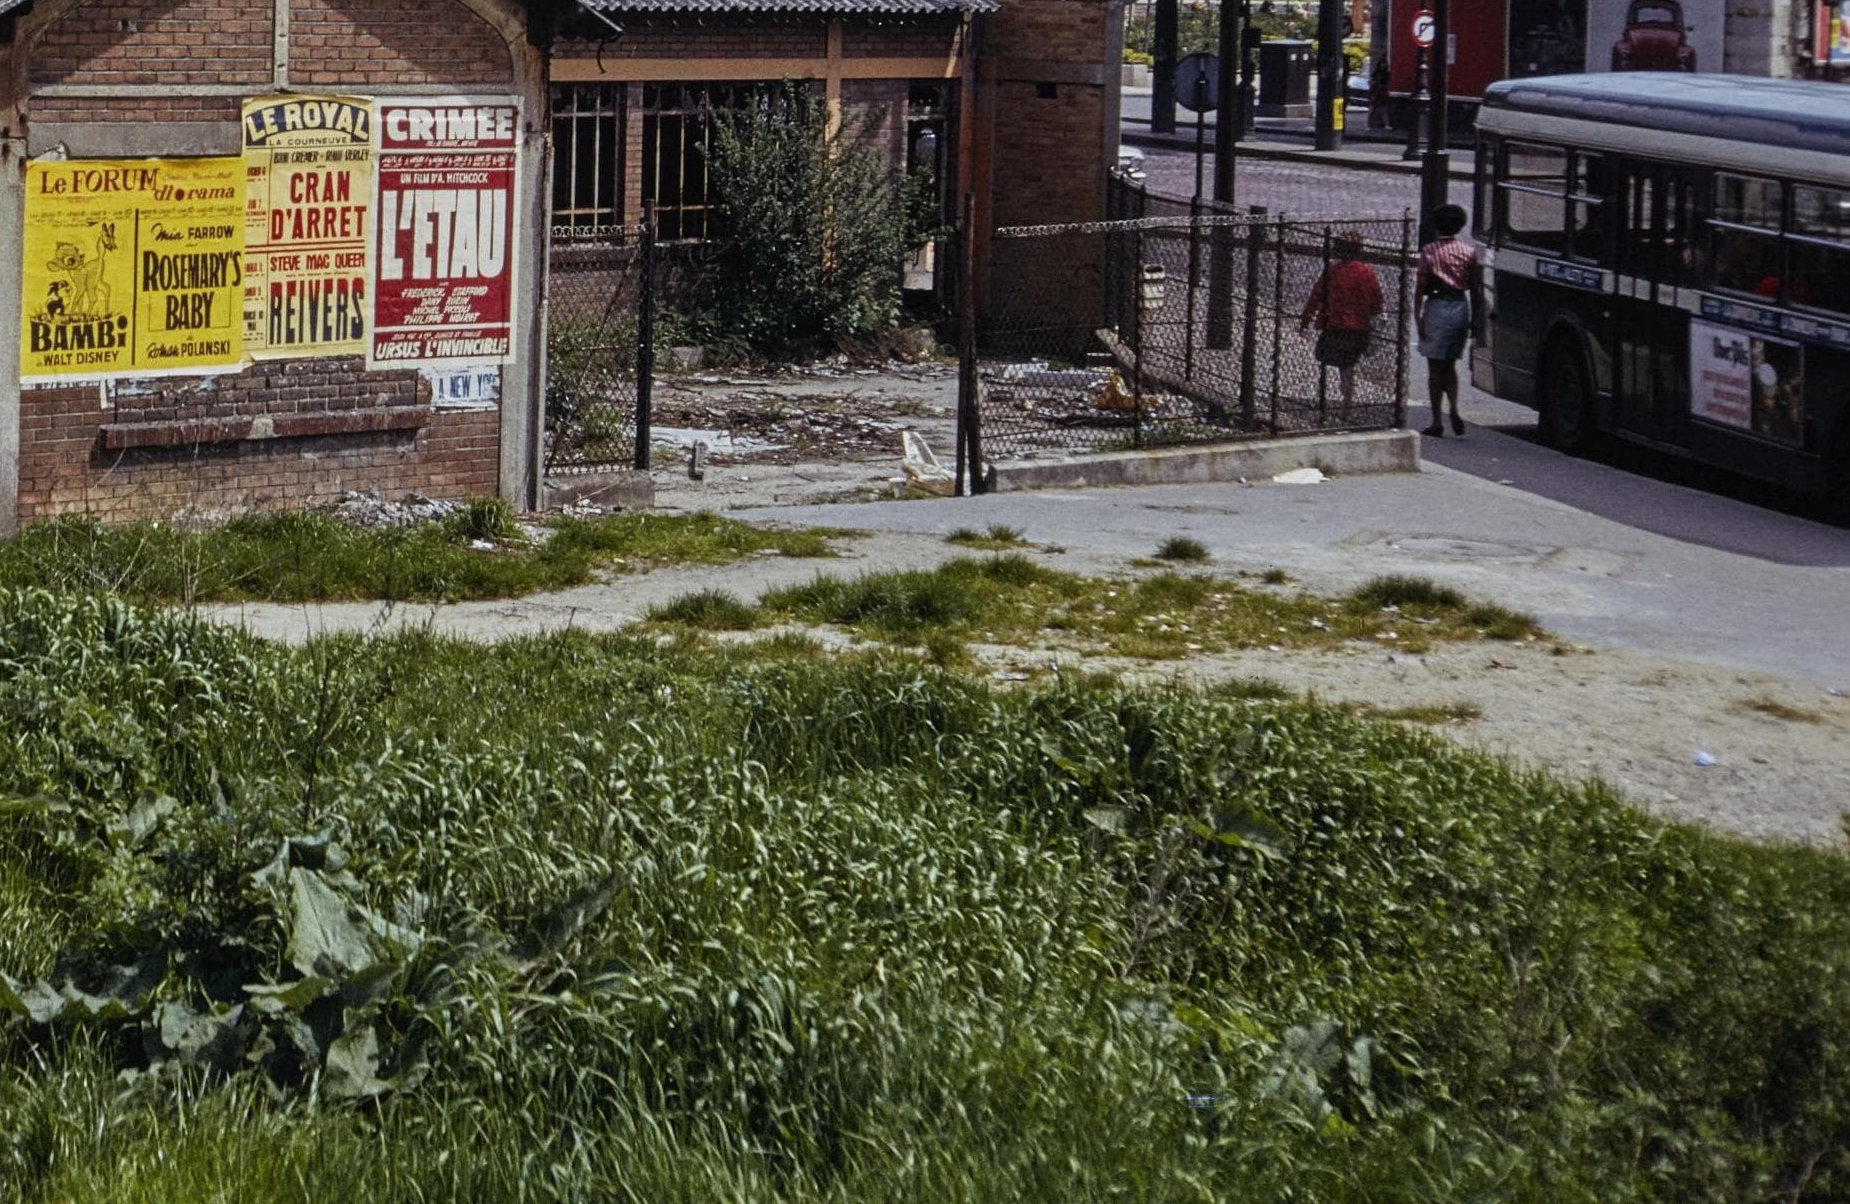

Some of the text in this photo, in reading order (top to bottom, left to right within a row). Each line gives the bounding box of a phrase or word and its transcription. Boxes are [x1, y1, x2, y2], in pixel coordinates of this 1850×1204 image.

[246, 101, 369, 142] LE ROYAL
[269, 136, 348, 146] LA COURNEUVE
[40, 167, 160, 194] Le FORUM
[290, 171, 351, 204] CRAN
[400, 173, 412, 184] UN
[413, 173, 431, 184] FILM
[447, 172, 489, 184] HITCHCOCK
[151, 222, 234, 242] Mia FARROW
[271, 206, 367, 240] D'ARRET
[381, 188, 506, 281] L'ETAU
[142, 249, 241, 292] ROSEMARY'S
[270, 255, 301, 272] STEVE
[306, 253, 330, 270] MAC
[335, 252, 365, 269] QUEEN
[165, 291, 215, 331] BABY
[269, 277, 365, 345] REIVERS
[43, 353, 73, 366] WALT
[76, 351, 119, 364] DISNEY
[180, 340, 231, 357] POLANSKI
[376, 337, 508, 359] URSUS L'INVINCIBLE
[450, 374, 471, 398] NEW
